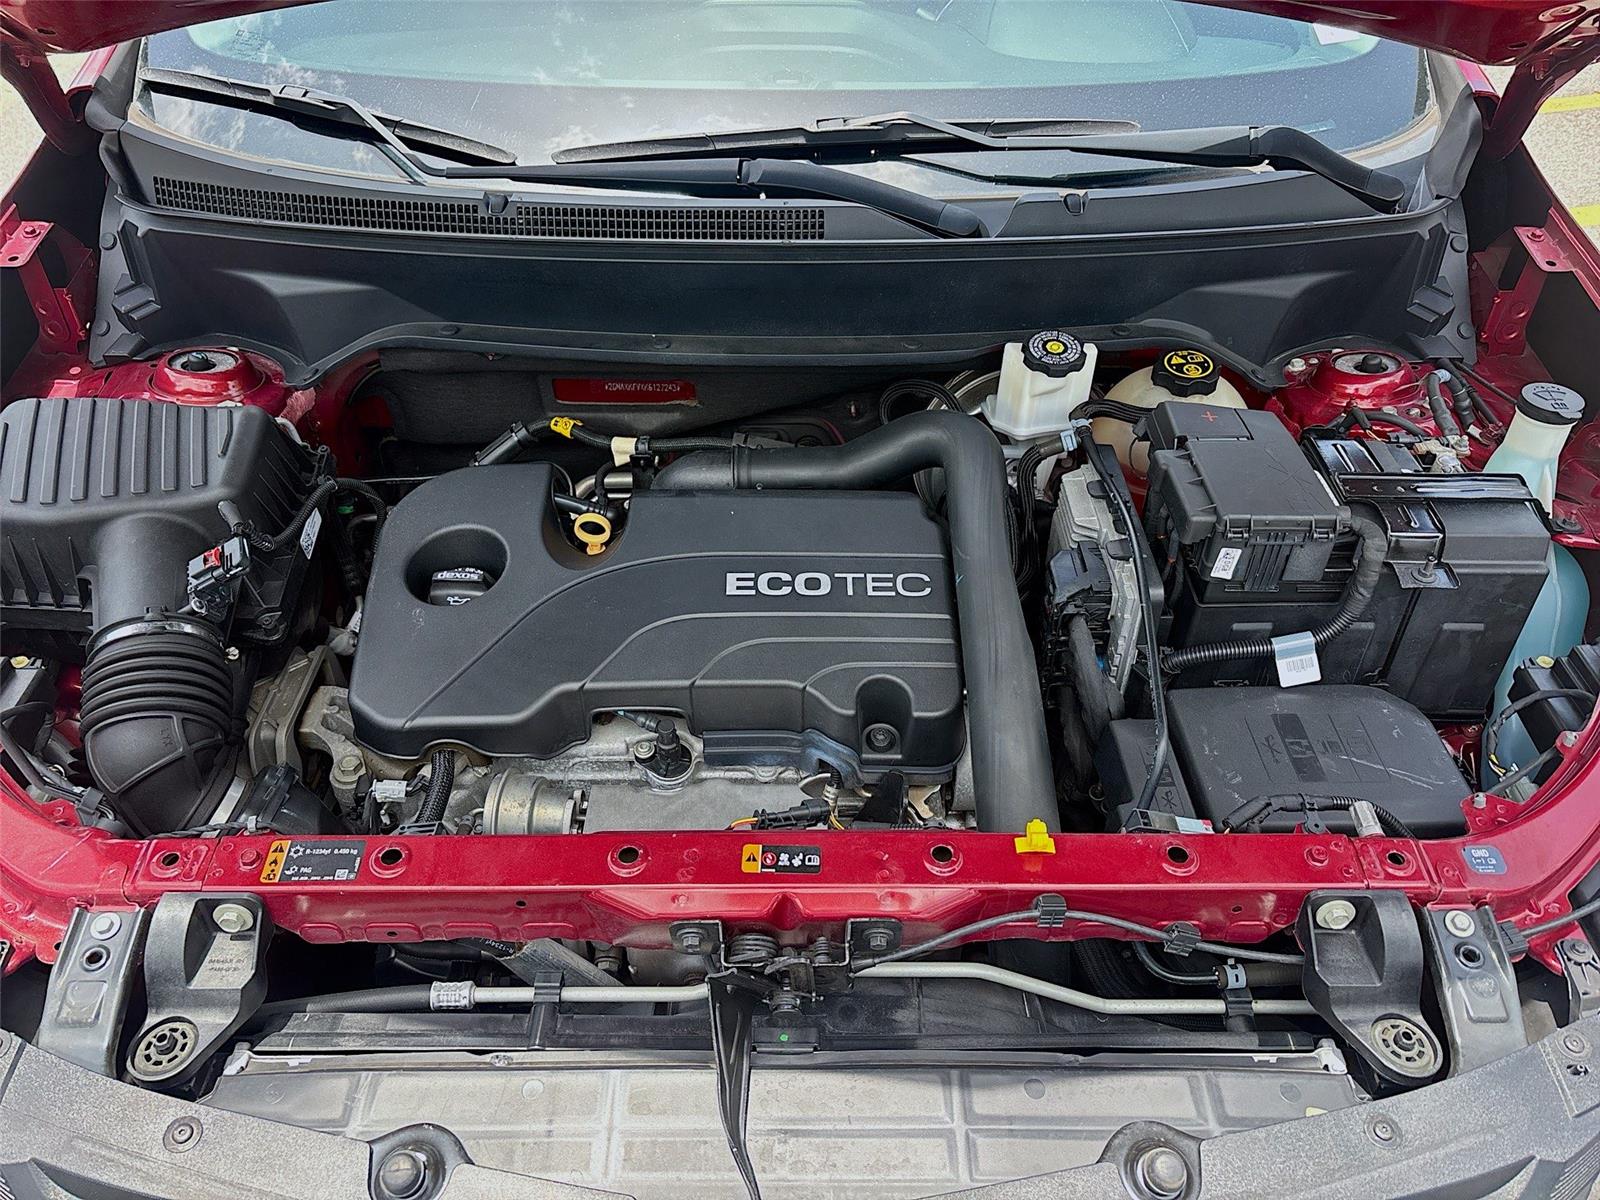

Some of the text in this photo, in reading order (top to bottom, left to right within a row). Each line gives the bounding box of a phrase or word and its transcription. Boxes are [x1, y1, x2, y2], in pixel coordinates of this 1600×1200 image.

[437, 571, 479, 579] dexos
[725, 572, 932, 597] ECOTEC
[1471, 849, 1489, 858] GND
